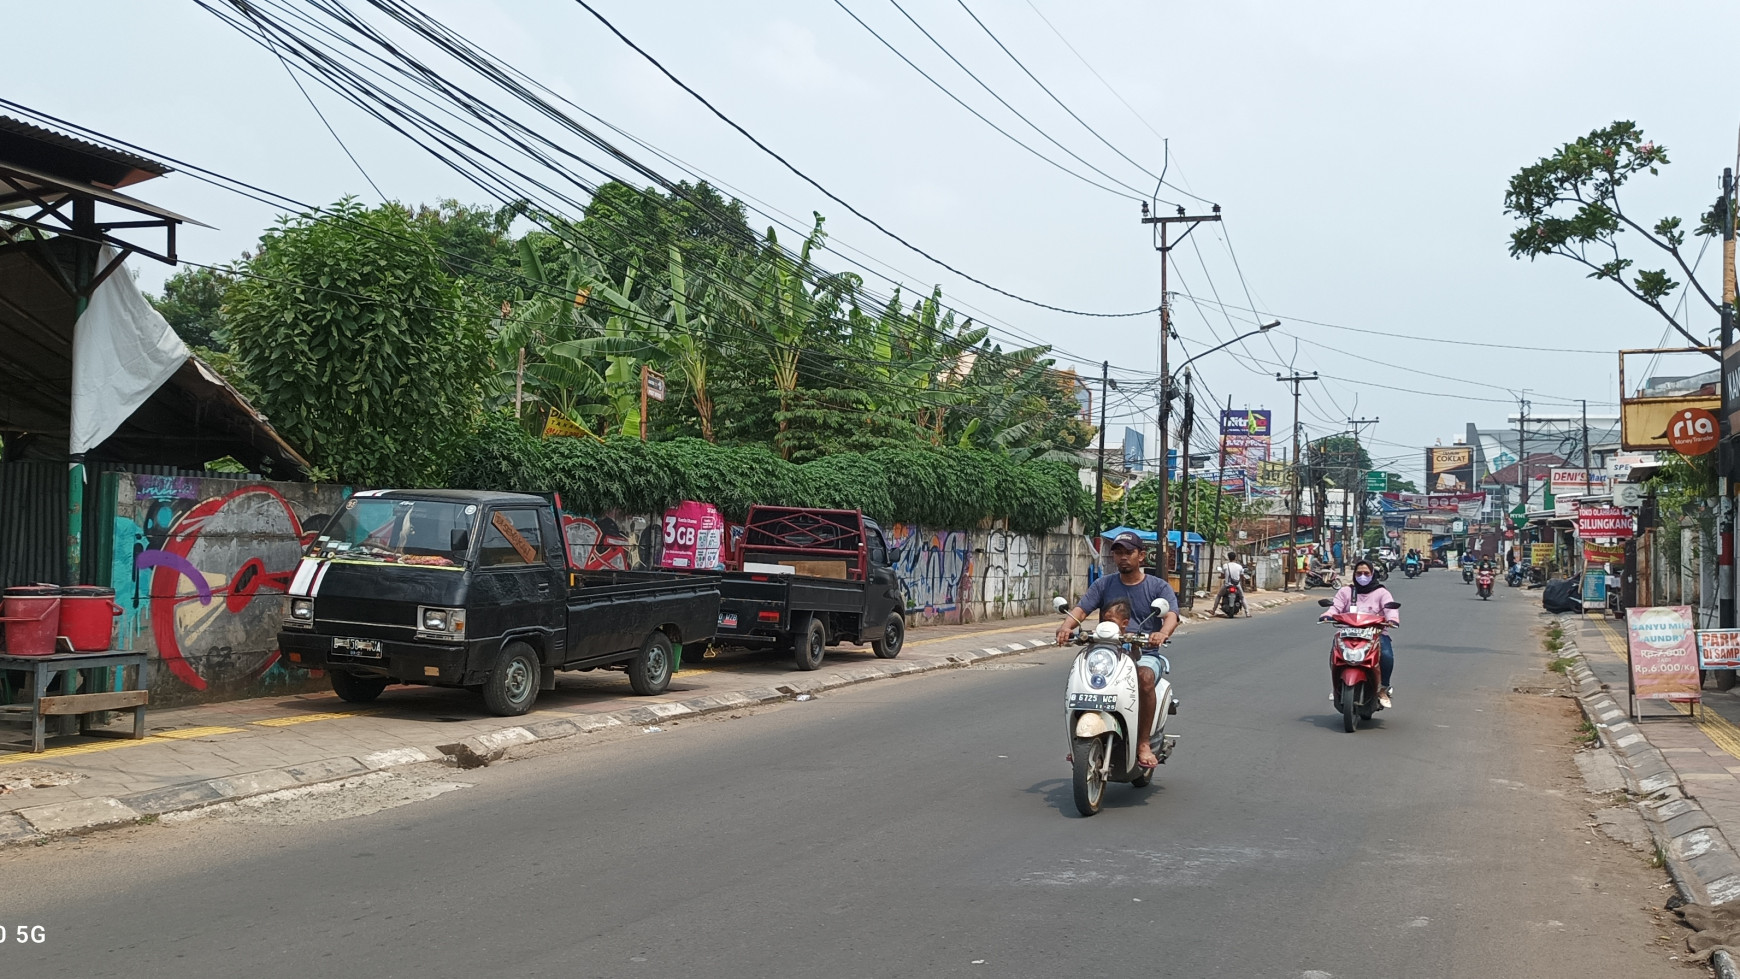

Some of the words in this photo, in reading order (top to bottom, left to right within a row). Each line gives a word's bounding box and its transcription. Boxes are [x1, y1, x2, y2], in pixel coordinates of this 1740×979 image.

[1673, 412, 1713, 437] ria
[1693, 435, 1714, 443] Transfer
[1579, 508, 1592, 516] TOKO
[1593, 508, 1620, 516] OLAHRAGA
[1579, 518, 1633, 530] SILUNGKANG
[1703, 650, 1713, 660] DI
[1078, 694, 1098, 702] 6725
